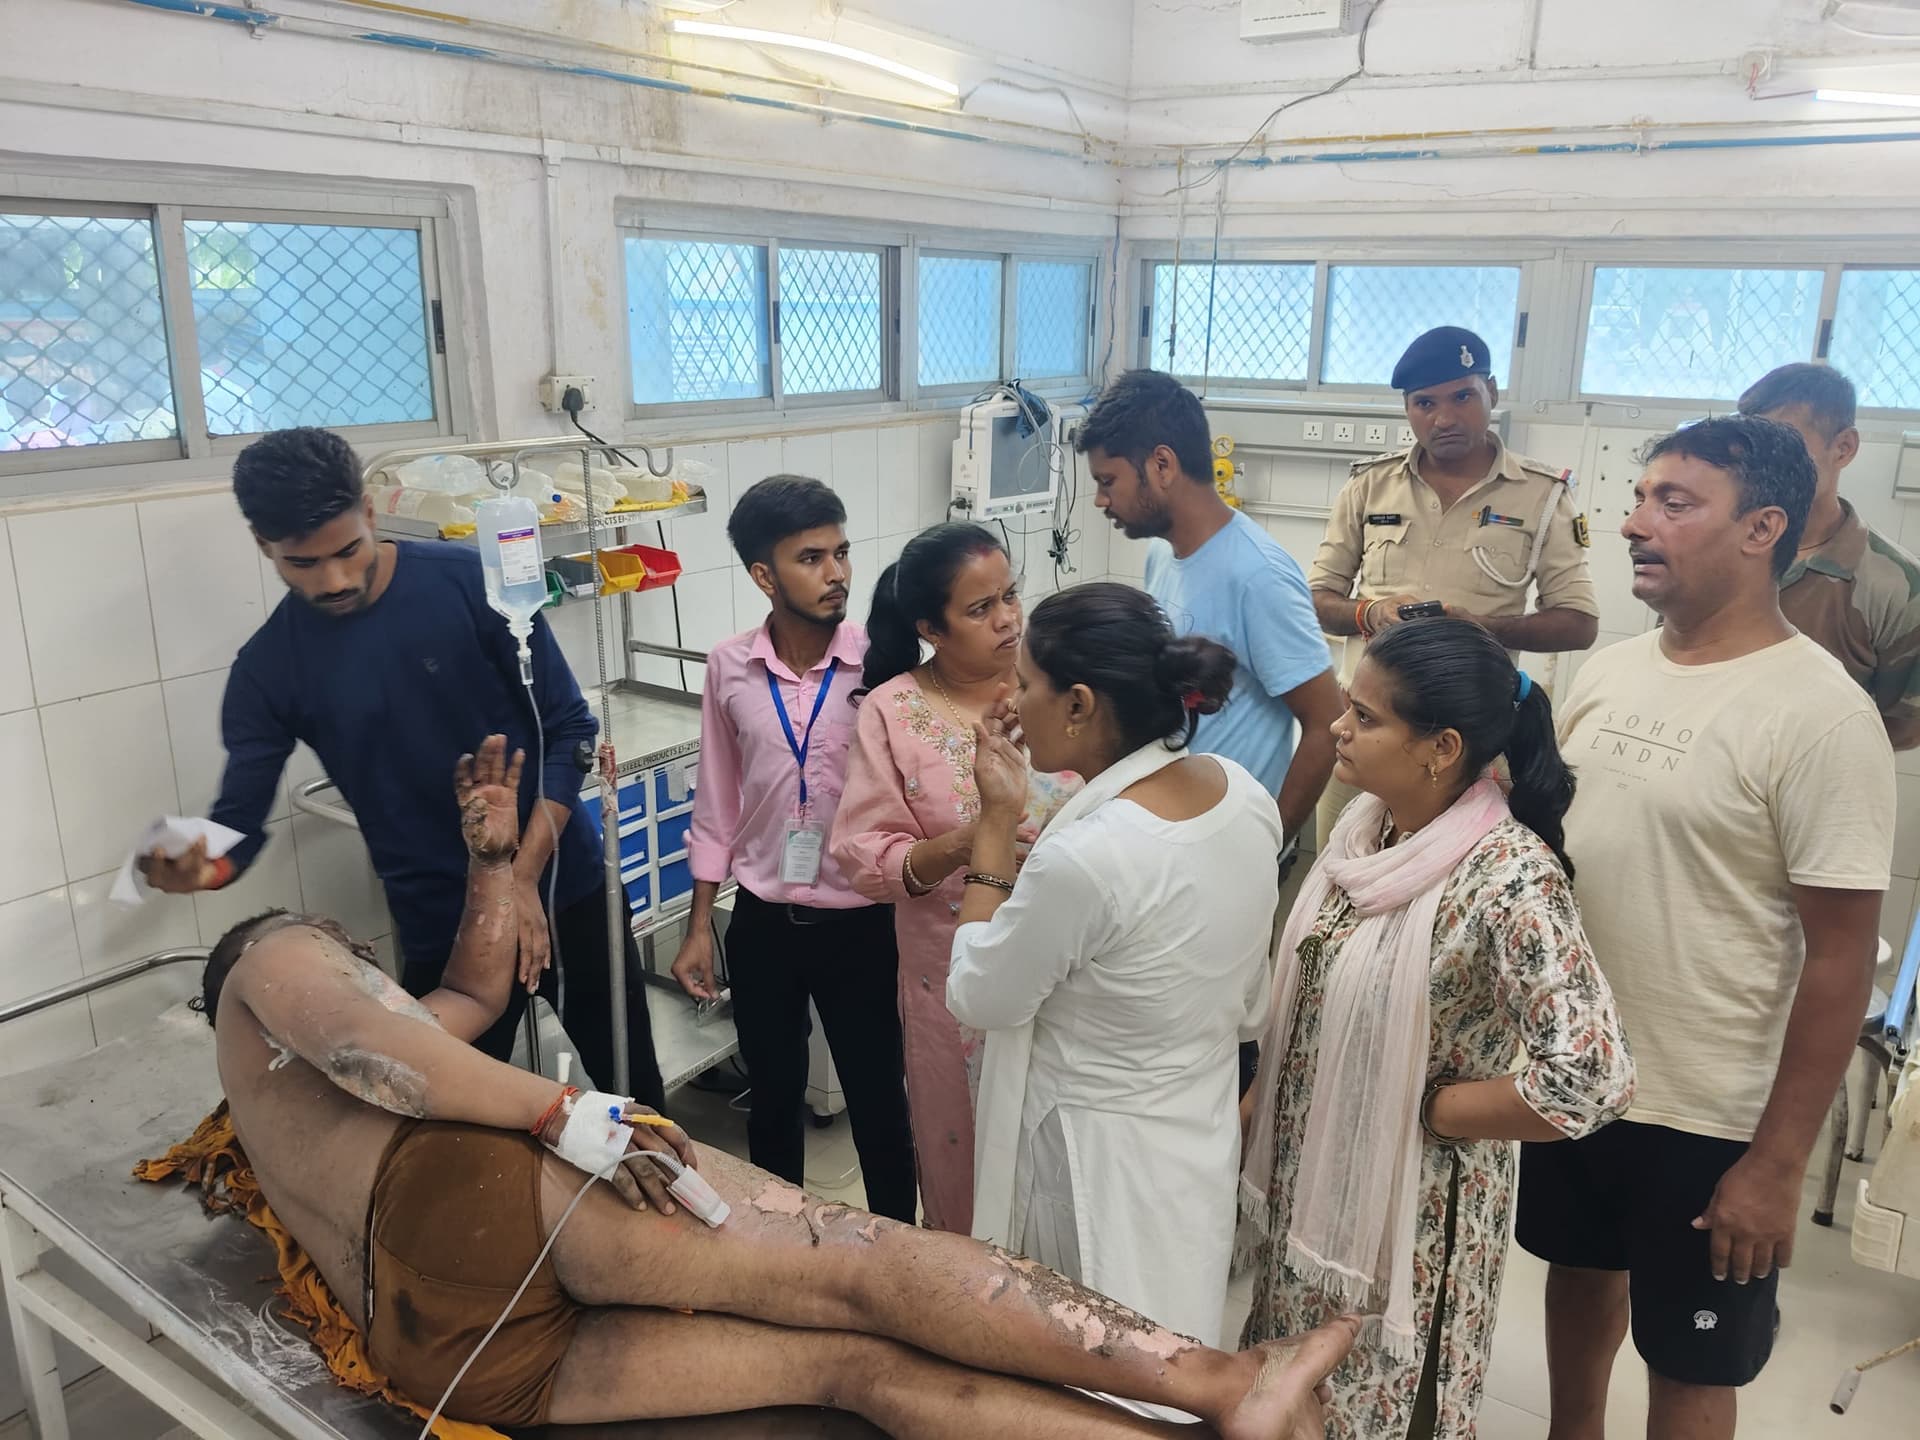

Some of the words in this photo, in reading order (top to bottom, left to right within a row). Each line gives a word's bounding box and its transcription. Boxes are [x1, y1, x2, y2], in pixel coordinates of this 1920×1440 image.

[580, 513, 617, 529] PRDUCTS
[1604, 711, 1693, 744] SOHO
[622, 761, 642, 773] STEEL
[642, 748, 678, 766] PRODUCTS
[1590, 735, 1680, 771] LNDN
